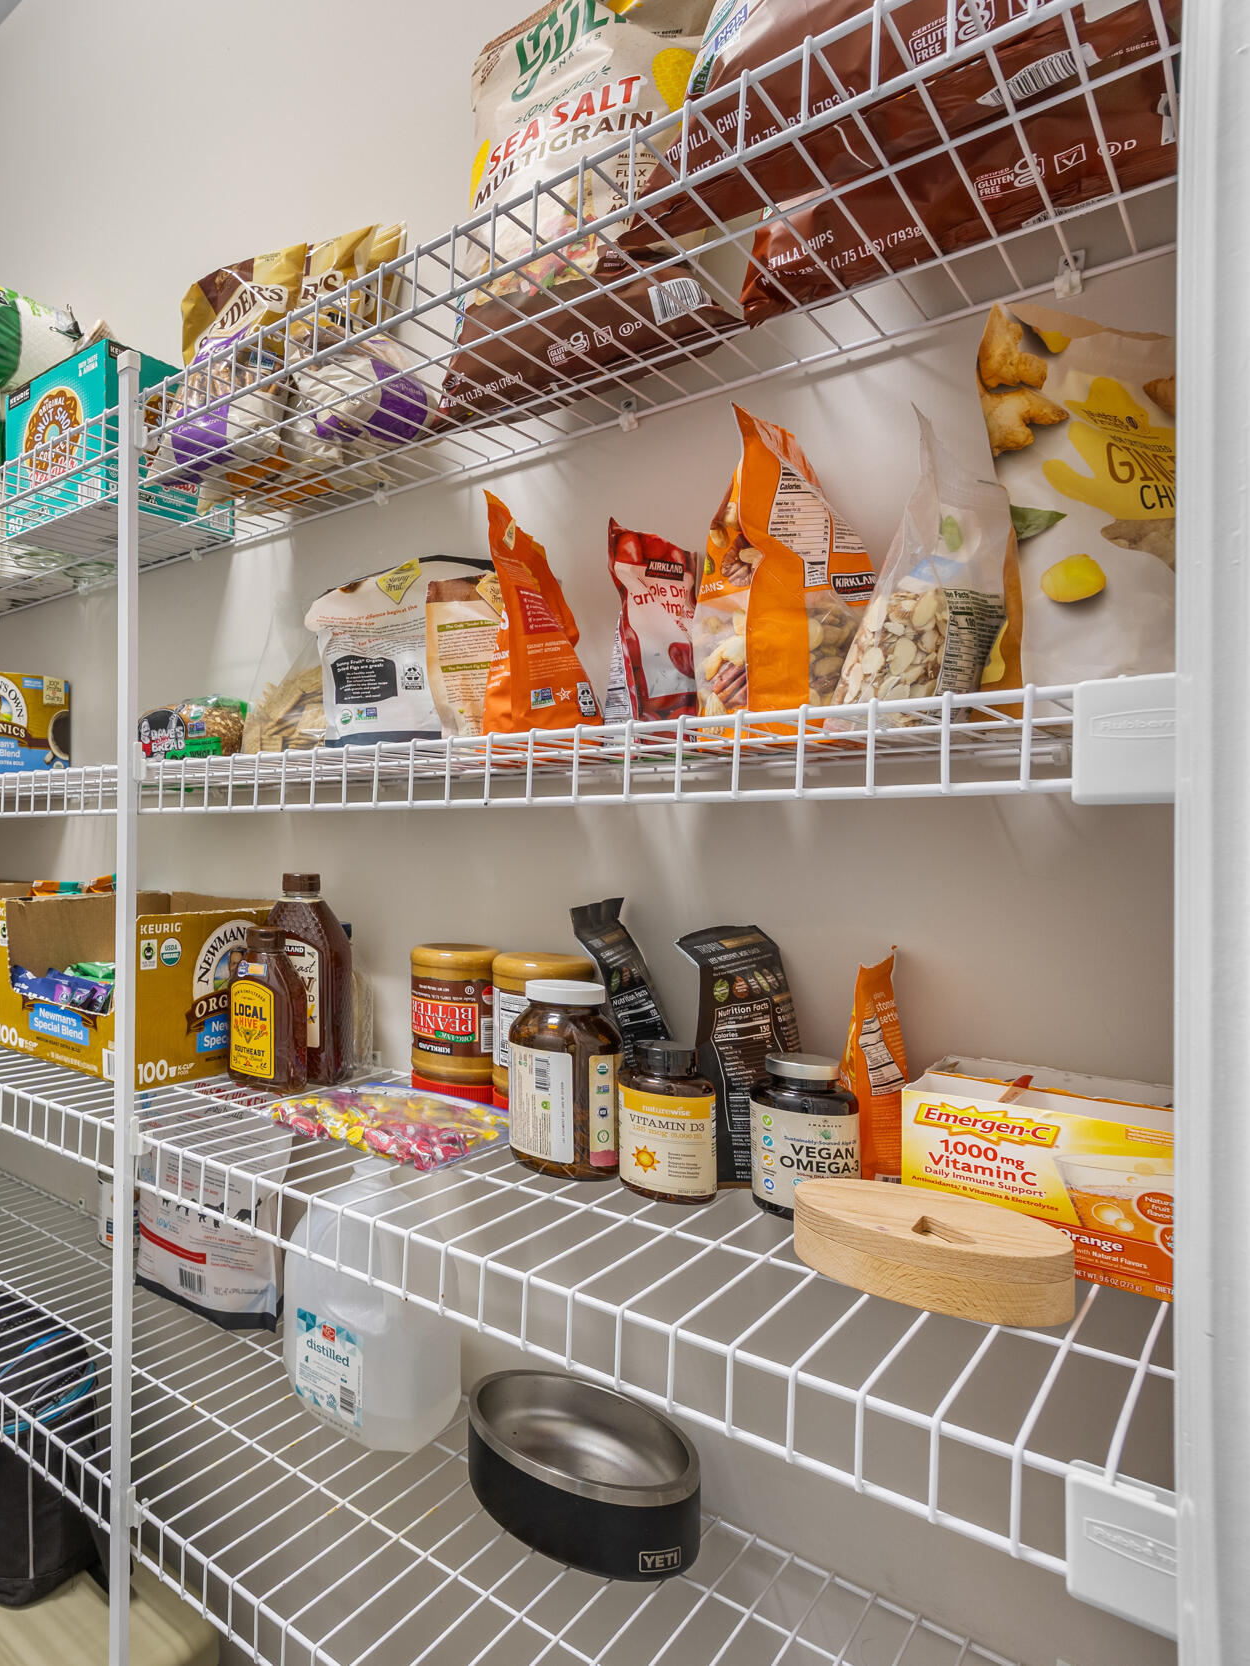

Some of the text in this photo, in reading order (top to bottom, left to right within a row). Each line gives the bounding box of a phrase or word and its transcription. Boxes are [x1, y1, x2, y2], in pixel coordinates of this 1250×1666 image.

[550, 32, 601, 75] SNACKS
[916, 44, 942, 63] FREE
[488, 75, 641, 175] SEA SALT
[474, 111, 653, 210] MULTIGRAIN
[977, 173, 1015, 190] GLUTEN
[979, 185, 1001, 197] FREE
[9, 388, 31, 405] KEURIG
[38, 396, 65, 417] ORIGINAL
[649, 561, 683, 574] KIRKLAND
[8, 689, 24, 718] OWN
[151, 726, 184, 740] DAVE'S
[0, 748, 20, 758] Blend
[151, 739, 185, 752] BREAD
[141, 923, 181, 935] KEURIG
[613, 989, 648, 1006] Nutrition Facts
[39, 1008, 77, 1027] Newman's
[234, 1002, 267, 1021] LOCAL
[412, 999, 472, 1019] BUTTER
[718, 1002, 769, 1018] Nutrition Facts
[33, 1017, 83, 1040] Special Blend
[239, 1017, 259, 1029] HIVE
[412, 1018, 472, 1032] PEANUT
[759, 1025, 770, 1033] 130
[438, 1031, 473, 1043] ORGANIC
[714, 1031, 738, 1039] Calories
[234, 1044, 265, 1057] SOUTHEAST
[419, 1042, 450, 1054] KIRKLAND
[138, 1059, 168, 1084] 100
[642, 1104, 691, 1117] naturewise
[630, 1113, 704, 1131] VITAMIN D3
[924, 1107, 1051, 1140] Emergen-C
[791, 1143, 854, 1160] VEGAN
[940, 1139, 1025, 1170] 1,000 mg
[779, 1155, 859, 1174] OMEGA-3
[928, 1151, 1038, 1186] Vitamin C
[924, 1166, 951, 1178] Daily
[953, 1172, 995, 1187] Immune
[1151, 1203, 1171, 1213] fruit
[1056, 1228, 1124, 1252] Orange
[1092, 1250, 1119, 1263] Natural
[1120, 1257, 1148, 1269] Flavors
[306, 1338, 350, 1368] distilled
[643, 1551, 678, 1569] YETI
